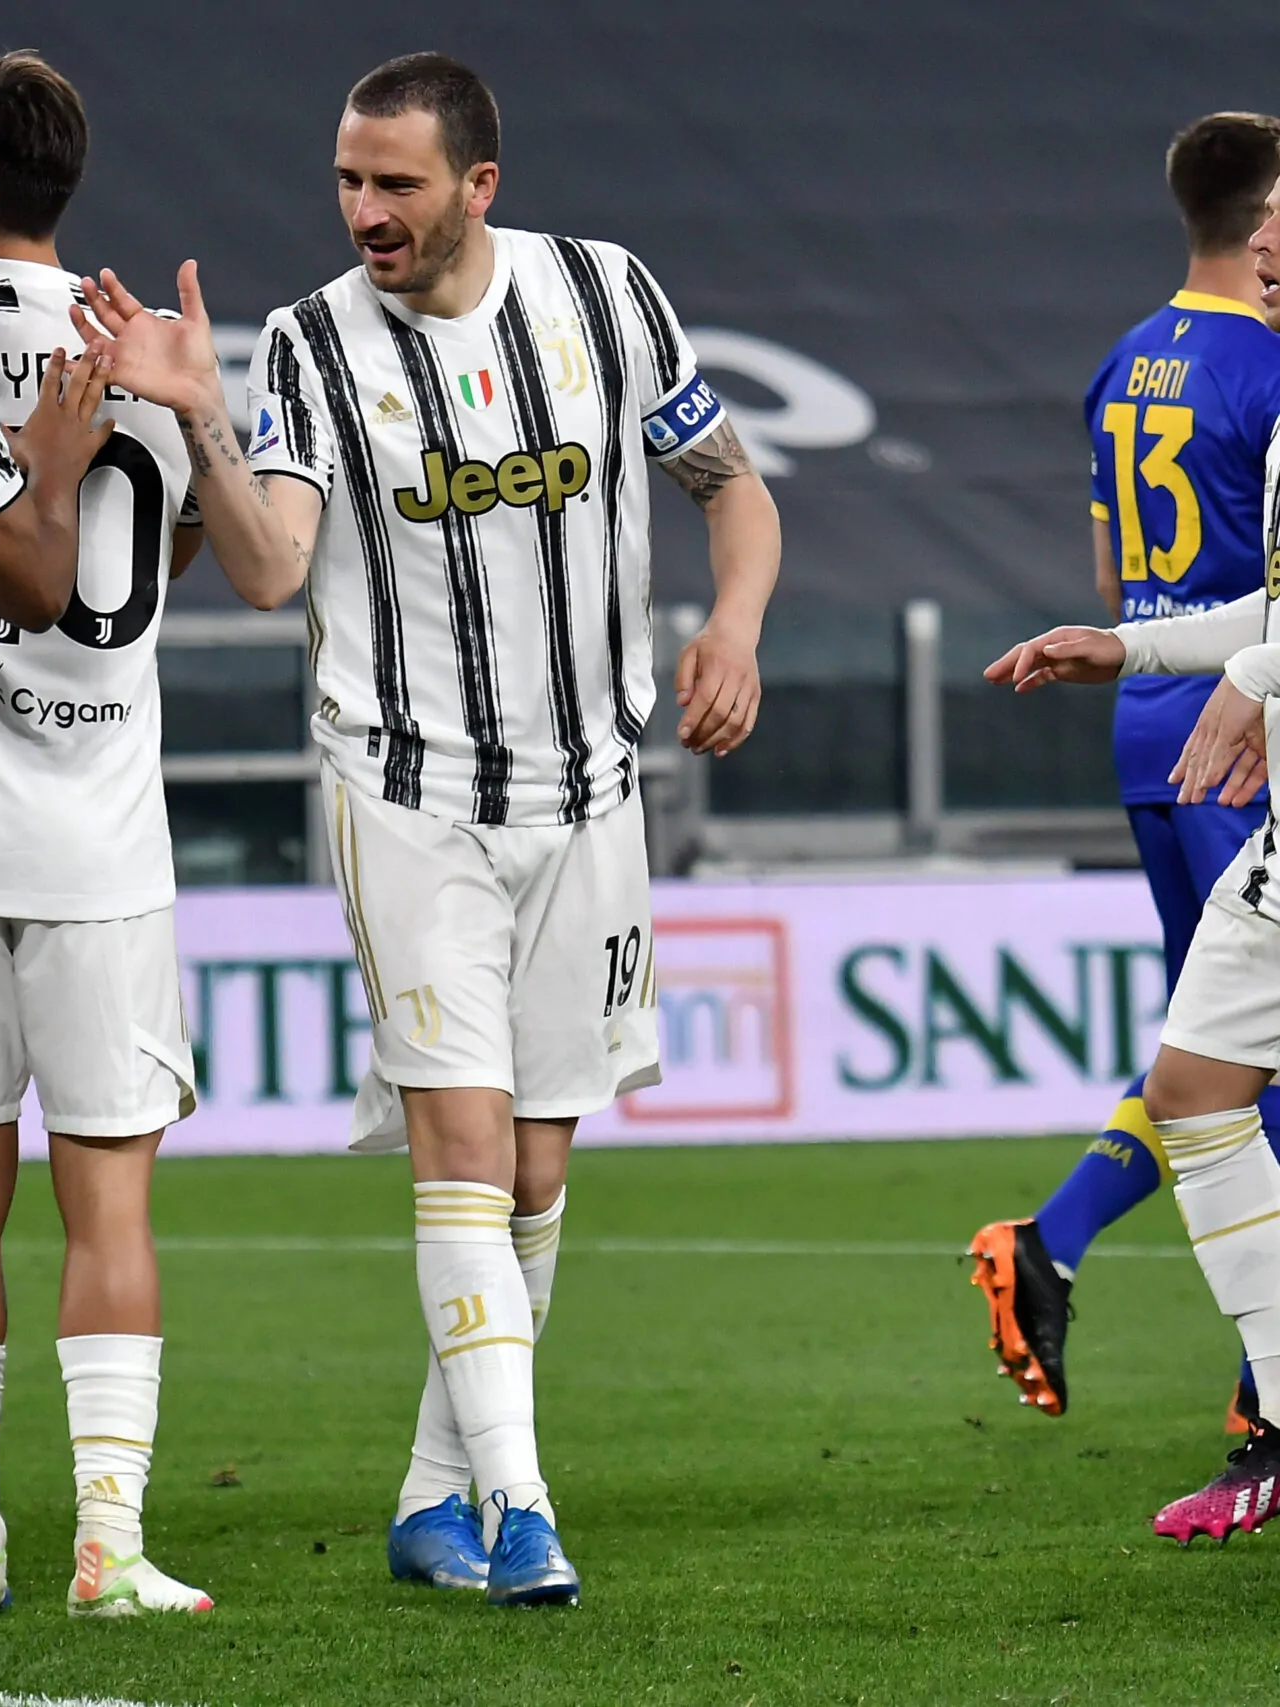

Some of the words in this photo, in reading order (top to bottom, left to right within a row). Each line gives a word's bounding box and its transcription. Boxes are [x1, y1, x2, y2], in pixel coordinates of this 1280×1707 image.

[676, 379, 717, 426] CAP
[1126, 356, 1190, 399] BANI
[392, 441, 591, 525] Jeep
[1102, 402, 1202, 584] 13
[603, 924, 641, 1019] 19
